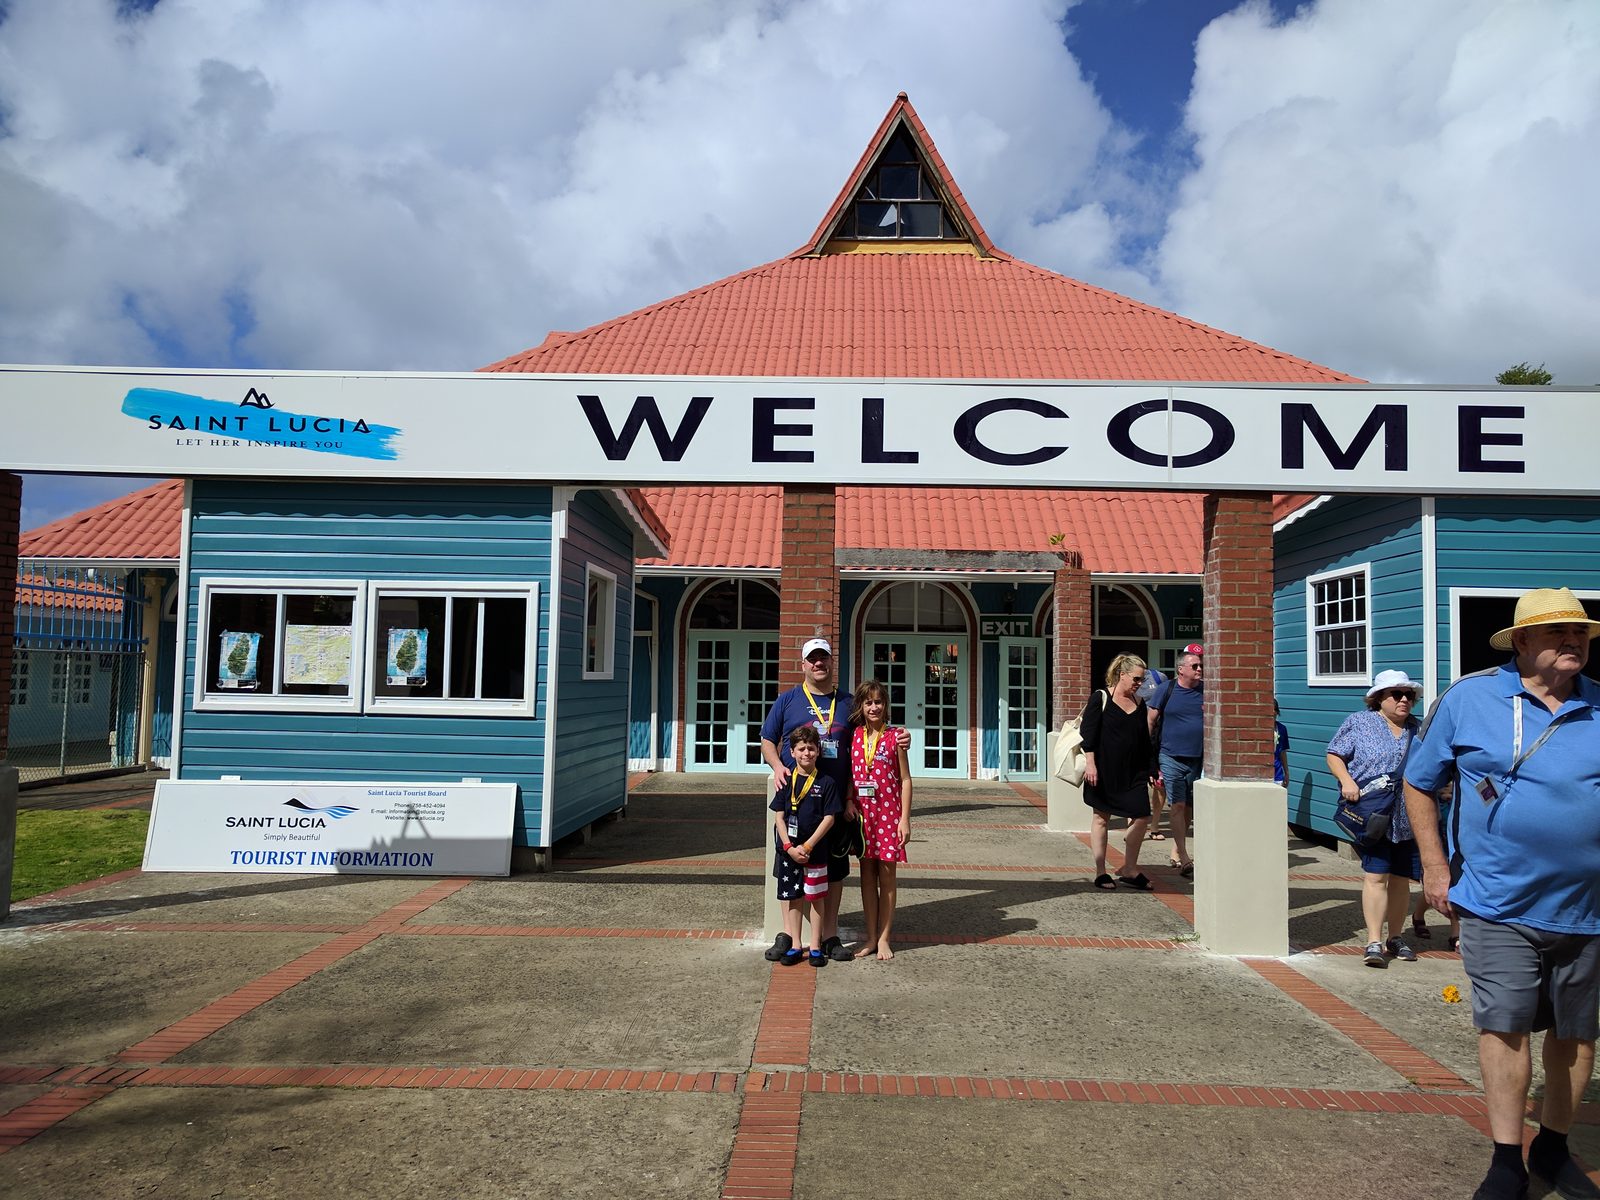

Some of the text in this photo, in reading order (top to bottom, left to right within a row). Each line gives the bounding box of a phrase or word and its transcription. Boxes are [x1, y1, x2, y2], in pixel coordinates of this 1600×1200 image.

[149, 415, 372, 433] SAINT LUCIA
[577, 395, 1525, 473] WELCOME
[176, 438, 344, 449] LET HER INSPIRE YOU
[981, 621, 1029, 635] EXIT
[1178, 624, 1199, 632] EXIT
[225, 816, 327, 828] SAINT LUCIA
[263, 833, 321, 841] Simply Beautiful
[230, 850, 434, 867] TOURIST INFORMATION
